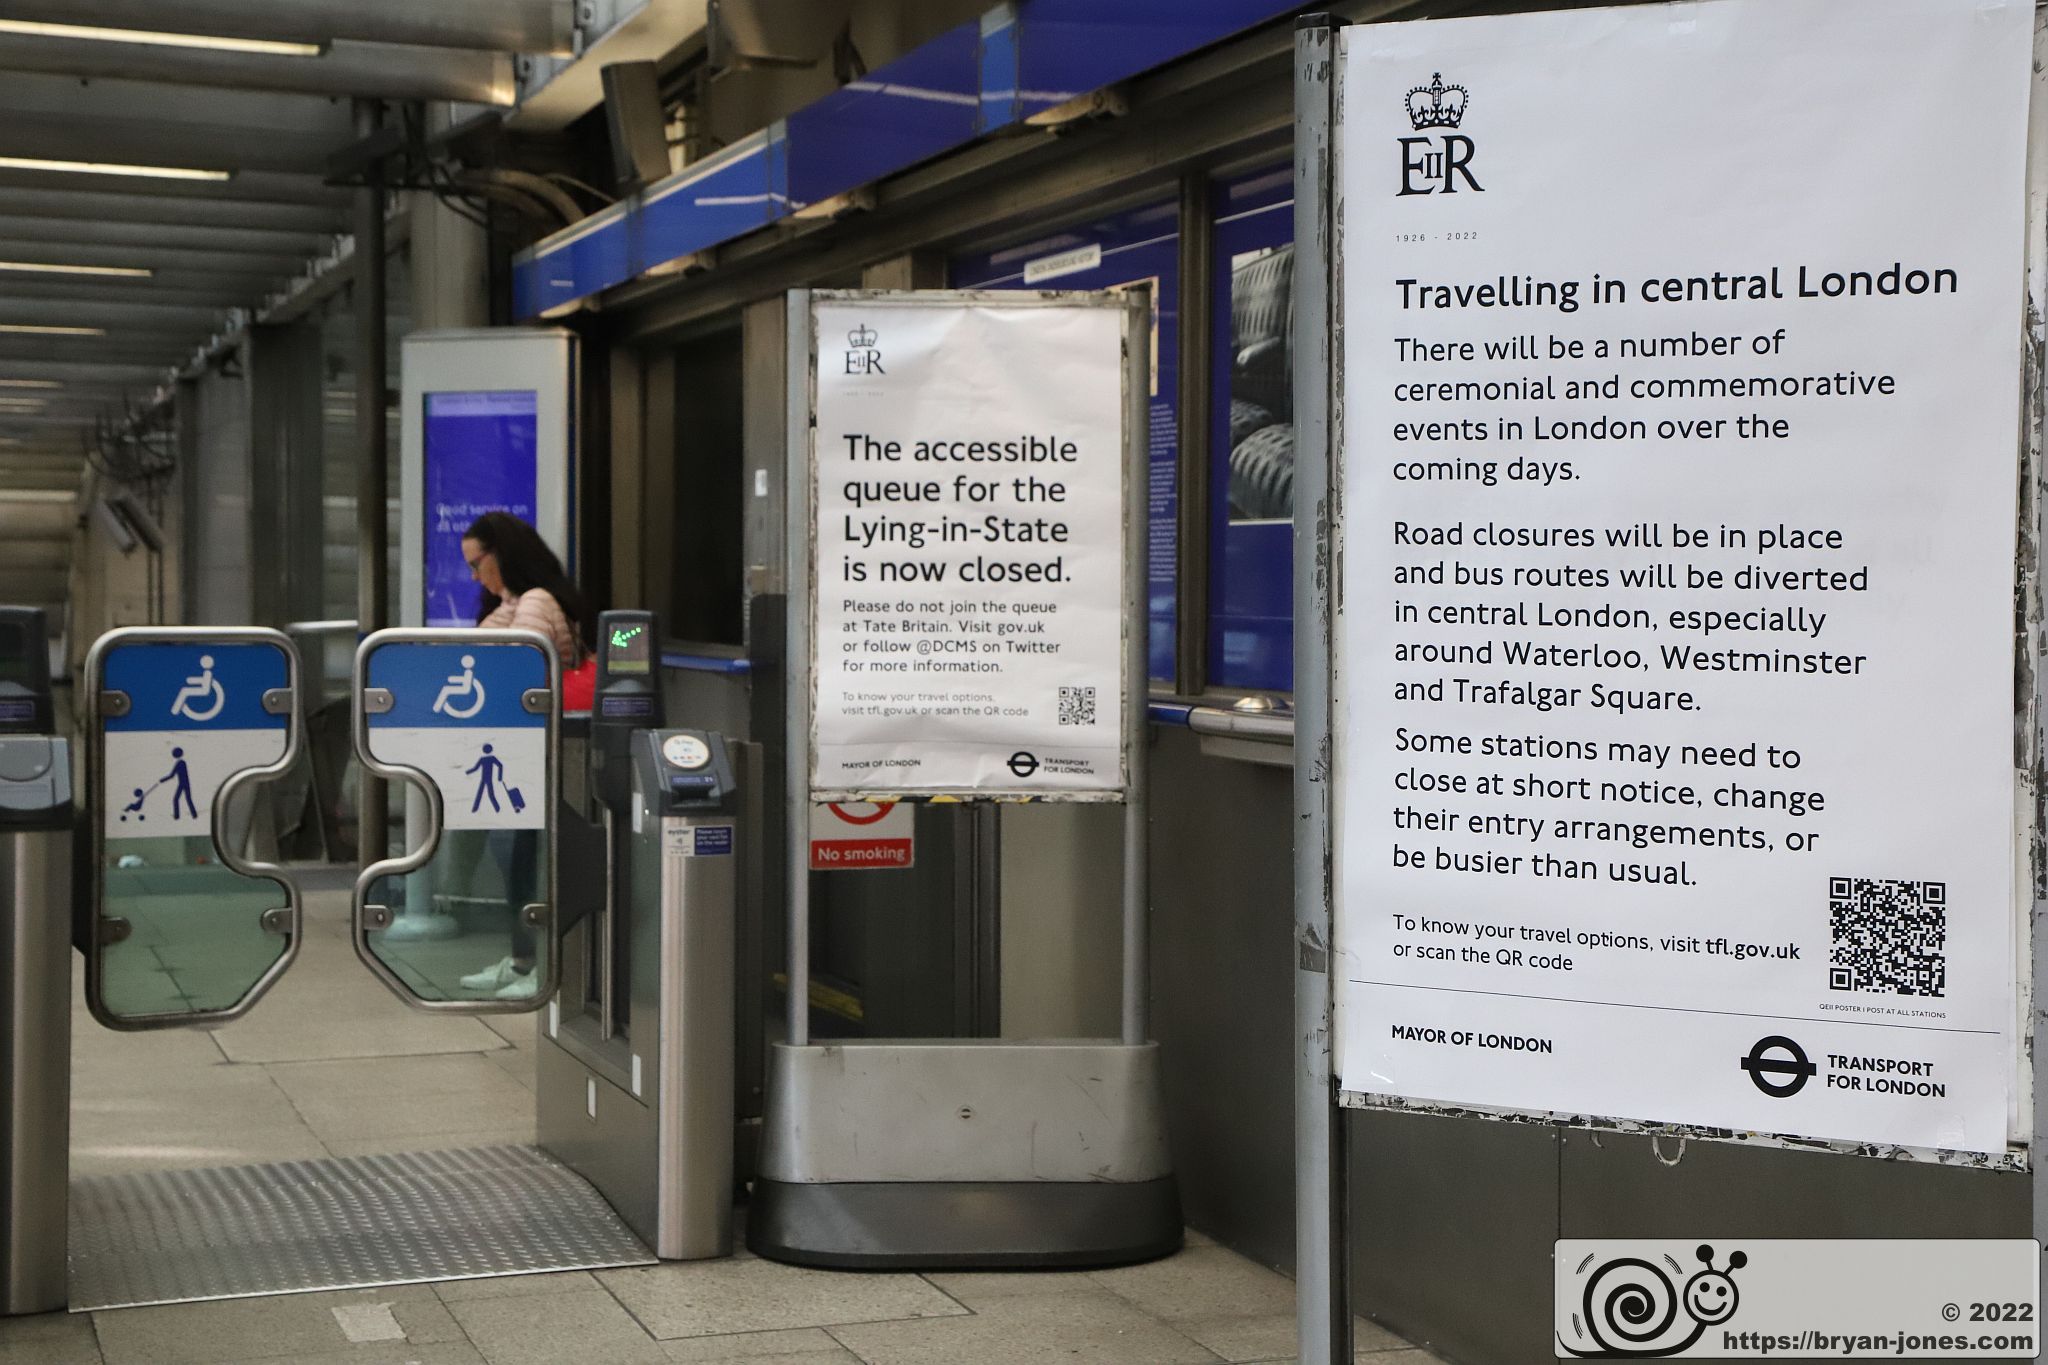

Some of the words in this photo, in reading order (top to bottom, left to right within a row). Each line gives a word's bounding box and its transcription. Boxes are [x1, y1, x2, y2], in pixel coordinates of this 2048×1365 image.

[1395, 233, 1426, 243] 1926
[1447, 231, 1477, 241] 2022
[1395, 275, 1580, 313] Travelling
[1593, 273, 1626, 304] in
[1641, 266, 1783, 303] central
[1798, 262, 1958, 298] London
[1394, 337, 1475, 362] There
[1484, 335, 1539, 360] will
[1549, 334, 1584, 360] be
[1594, 339, 1609, 359] a
[1620, 331, 1742, 358] number
[1752, 328, 1786, 355] of
[1394, 375, 1556, 402] ceremonial
[1565, 374, 1619, 400] and
[1630, 370, 1895, 399] commemorative
[1393, 419, 1488, 442] events
[1498, 417, 1523, 441] in
[1535, 415, 1646, 440] London
[1657, 419, 1727, 440] over
[1736, 413, 1789, 439] the
[842, 433, 902, 462] The
[914, 435, 1078, 463] accessible
[1393, 457, 1498, 487] coming
[1507, 456, 1580, 487] days.
[843, 481, 941, 509] queue
[952, 474, 1001, 503] for
[1012, 475, 1066, 503] the
[844, 514, 1069, 549] Lying-in-State
[1394, 521, 1463, 546] Road
[1473, 521, 1595, 547] closures
[1604, 522, 1663, 548] will
[1673, 523, 1709, 548] be
[1720, 524, 1746, 548] in
[1758, 523, 1843, 555] place
[844, 555, 867, 582] is
[880, 561, 947, 582] now
[958, 555, 1071, 583] closed.
[1394, 560, 1444, 585] and
[1455, 561, 1504, 586] bus
[1514, 565, 1610, 588] routes
[1619, 563, 1677, 589] will
[1687, 563, 1724, 590] be
[1734, 564, 1868, 592] diverted
[843, 599, 891, 613] Please
[895, 599, 915, 613] do
[919, 601, 945, 613] not
[949, 599, 977, 616] join
[981, 600, 1007, 614] the
[1011, 603, 1057, 616] queue
[1395, 599, 1418, 623] in
[1427, 601, 1528, 626] central
[1538, 602, 1658, 632] London,
[1669, 606, 1827, 639] especially
[842, 620, 858, 633] at
[862, 619, 897, 633] Tate
[901, 619, 952, 633] Britain.
[958, 619, 992, 633] Visit
[997, 620, 1045, 637] gov.uk
[842, 642, 858, 653] or
[863, 639, 912, 653] follow
[916, 639, 977, 656] @DCMS
[982, 642, 1001, 653] on
[1005, 640, 1061, 654] Twitter
[1395, 640, 1492, 665] around
[1502, 640, 1649, 672] Waterloo,
[1660, 644, 1867, 675] Westminster
[842, 658, 865, 672] for
[869, 662, 908, 672] more
[913, 659, 1003, 673] information.
[841, 706, 864, 715] visit
[866, 704, 919, 717] tfl.gov.uk
[920, 707, 932, 716] or
[935, 707, 960, 716] scan
[962, 705, 981, 716] the
[983, 705, 1001, 716] QR
[1002, 707, 1029, 717] code
[842, 691, 855, 701] To
[857, 692, 887, 701] know
[890, 692, 915, 703] your
[917, 692, 949, 702] travel
[1394, 678, 1443, 702] and
[1452, 678, 1582, 712] Trafalgar
[1590, 683, 1701, 715] Square.
[841, 761, 871, 769] MAYOR
[872, 760, 884, 768] OF
[885, 758, 921, 768] LONDON
[1044, 757, 1090, 767] TRANSPORT
[1395, 727, 1472, 755] Some
[1481, 734, 1598, 761] stations
[1608, 743, 1671, 770] may
[1681, 742, 1756, 767] need
[1766, 745, 1801, 769] to
[1060, 766, 1096, 775] LONDON
[1394, 767, 1467, 794] close
[1476, 773, 1504, 796] at
[1512, 772, 1591, 800] short
[1601, 780, 1702, 809] notice,
[1713, 782, 1825, 817] change
[1393, 805, 1460, 832] their
[1468, 813, 1545, 843] entry
[1554, 820, 1774, 853] arrangements,
[1785, 832, 1820, 852] or
[817, 846, 840, 861] No
[844, 846, 906, 863] smoking
[1393, 843, 1426, 869] be
[1435, 846, 1523, 875] busier
[1531, 852, 1597, 880] than
[1609, 860, 1697, 886] usual.
[1392, 913, 1416, 931] To
[1421, 916, 1470, 935] know
[1474, 924, 1515, 940] your
[1519, 925, 1572, 944] travel
[1576, 931, 1654, 952] options,
[1659, 935, 1701, 954] visit
[1705, 937, 1801, 961] tfl.gov.uk
[1393, 944, 1412, 957] or
[1416, 946, 1456, 961] scan
[1460, 946, 1491, 964] the
[1495, 948, 1523, 967] QR
[1528, 953, 1573, 971] code
[1835, 1004, 1861, 1012] POSTER
[1911, 1010, 1946, 1019] STATIONS
[1391, 1024, 1447, 1044] MAYOR
[1450, 1031, 1474, 1046] OF
[1478, 1033, 1552, 1054] LONDON
[1827, 1054, 1934, 1077] TRANSPORT
[1827, 1073, 1862, 1091] FOR
[1866, 1077, 1946, 1098] LONDON
